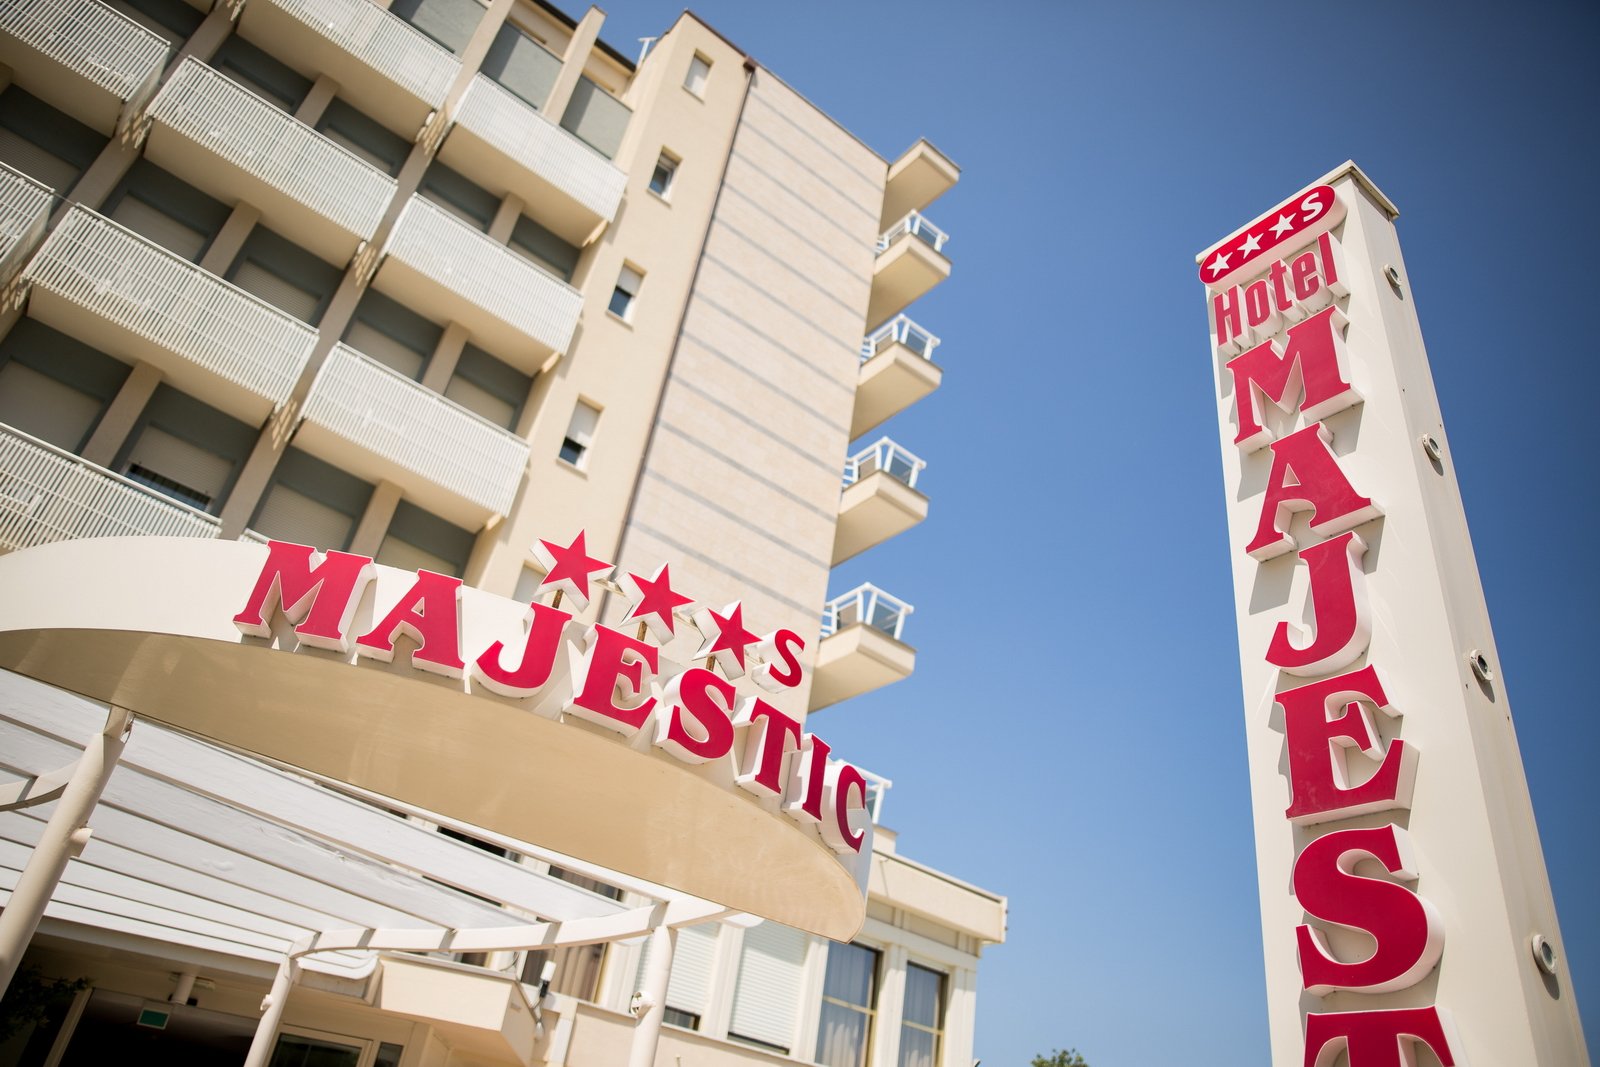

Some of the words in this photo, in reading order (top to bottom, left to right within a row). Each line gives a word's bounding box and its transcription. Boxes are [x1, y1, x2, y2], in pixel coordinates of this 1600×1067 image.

[1300, 191, 1324, 222] S
[1213, 231, 1339, 347] Hotel
[233, 540, 867, 853] MAJESTIC
[768, 629, 806, 688] S
